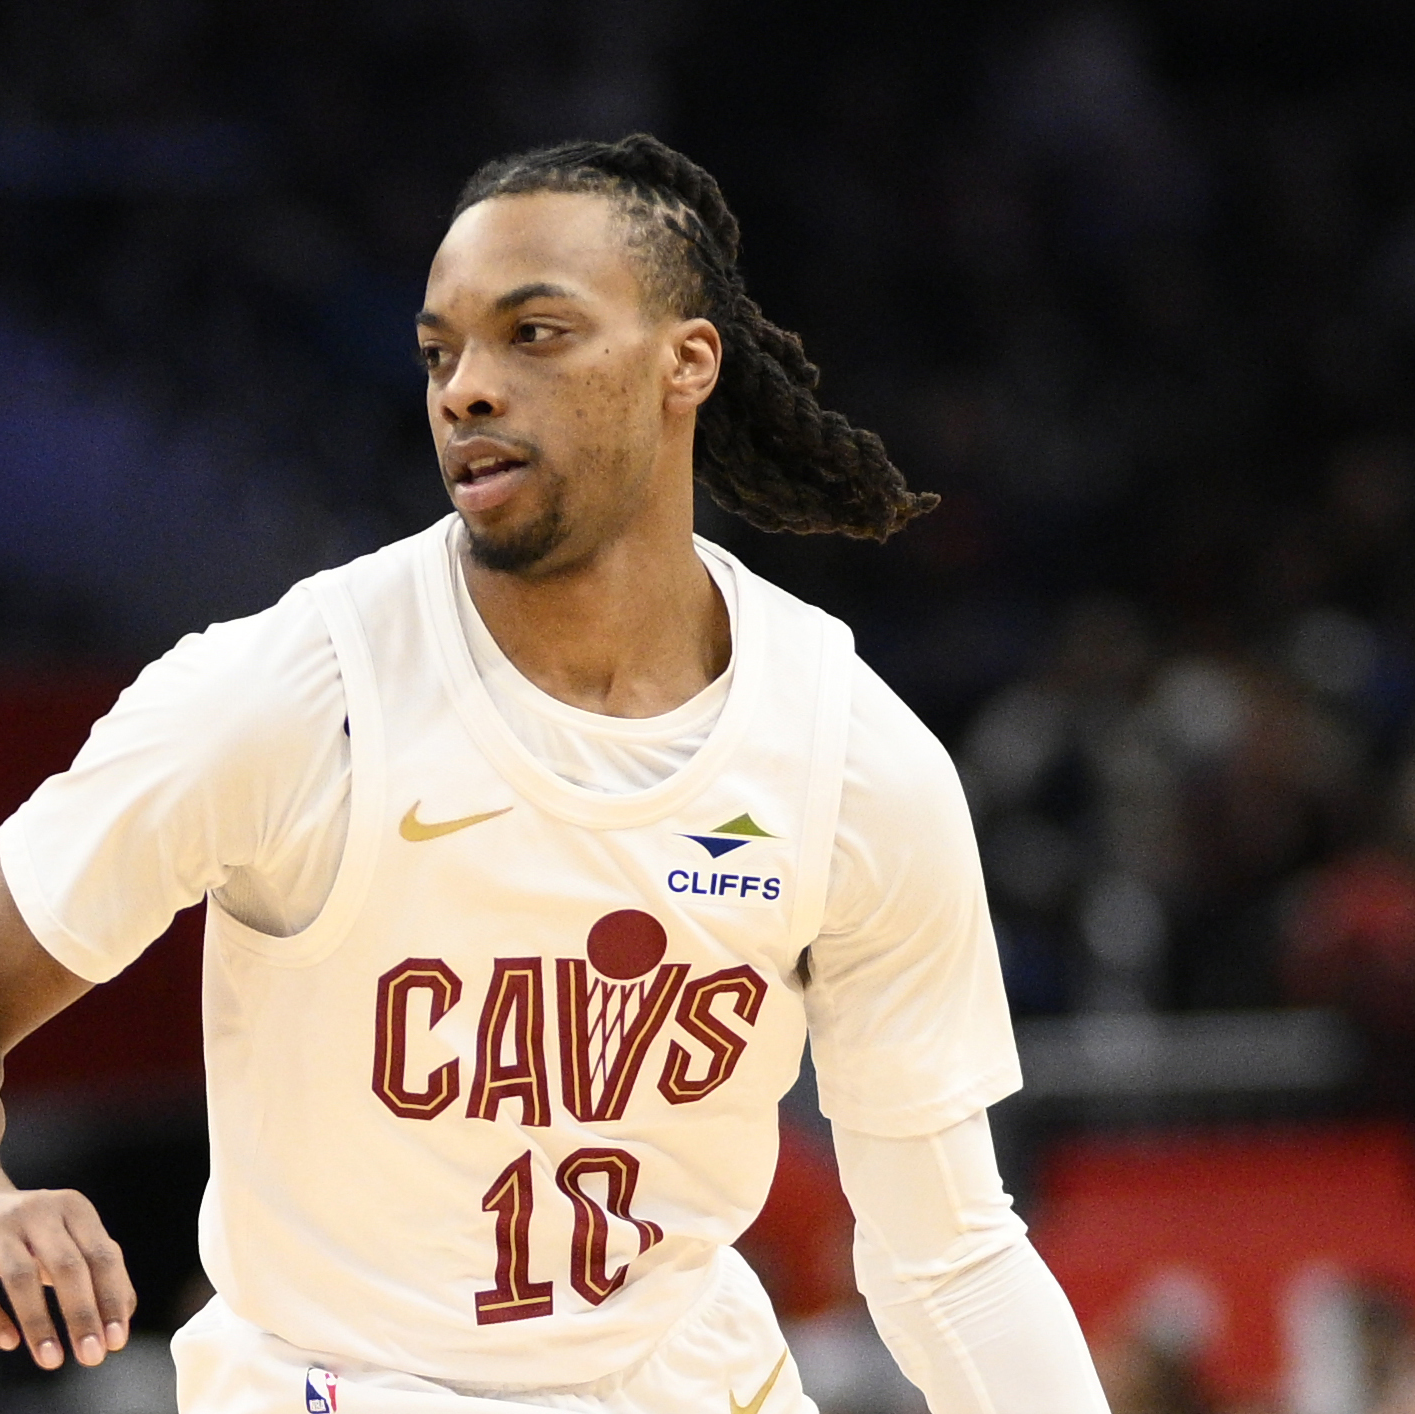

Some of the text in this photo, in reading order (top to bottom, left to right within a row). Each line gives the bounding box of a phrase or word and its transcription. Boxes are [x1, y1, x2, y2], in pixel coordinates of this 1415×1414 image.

[667, 869, 781, 900] CLIFFS
[372, 956, 768, 1127] CAVS
[474, 1147, 664, 1325] 10
